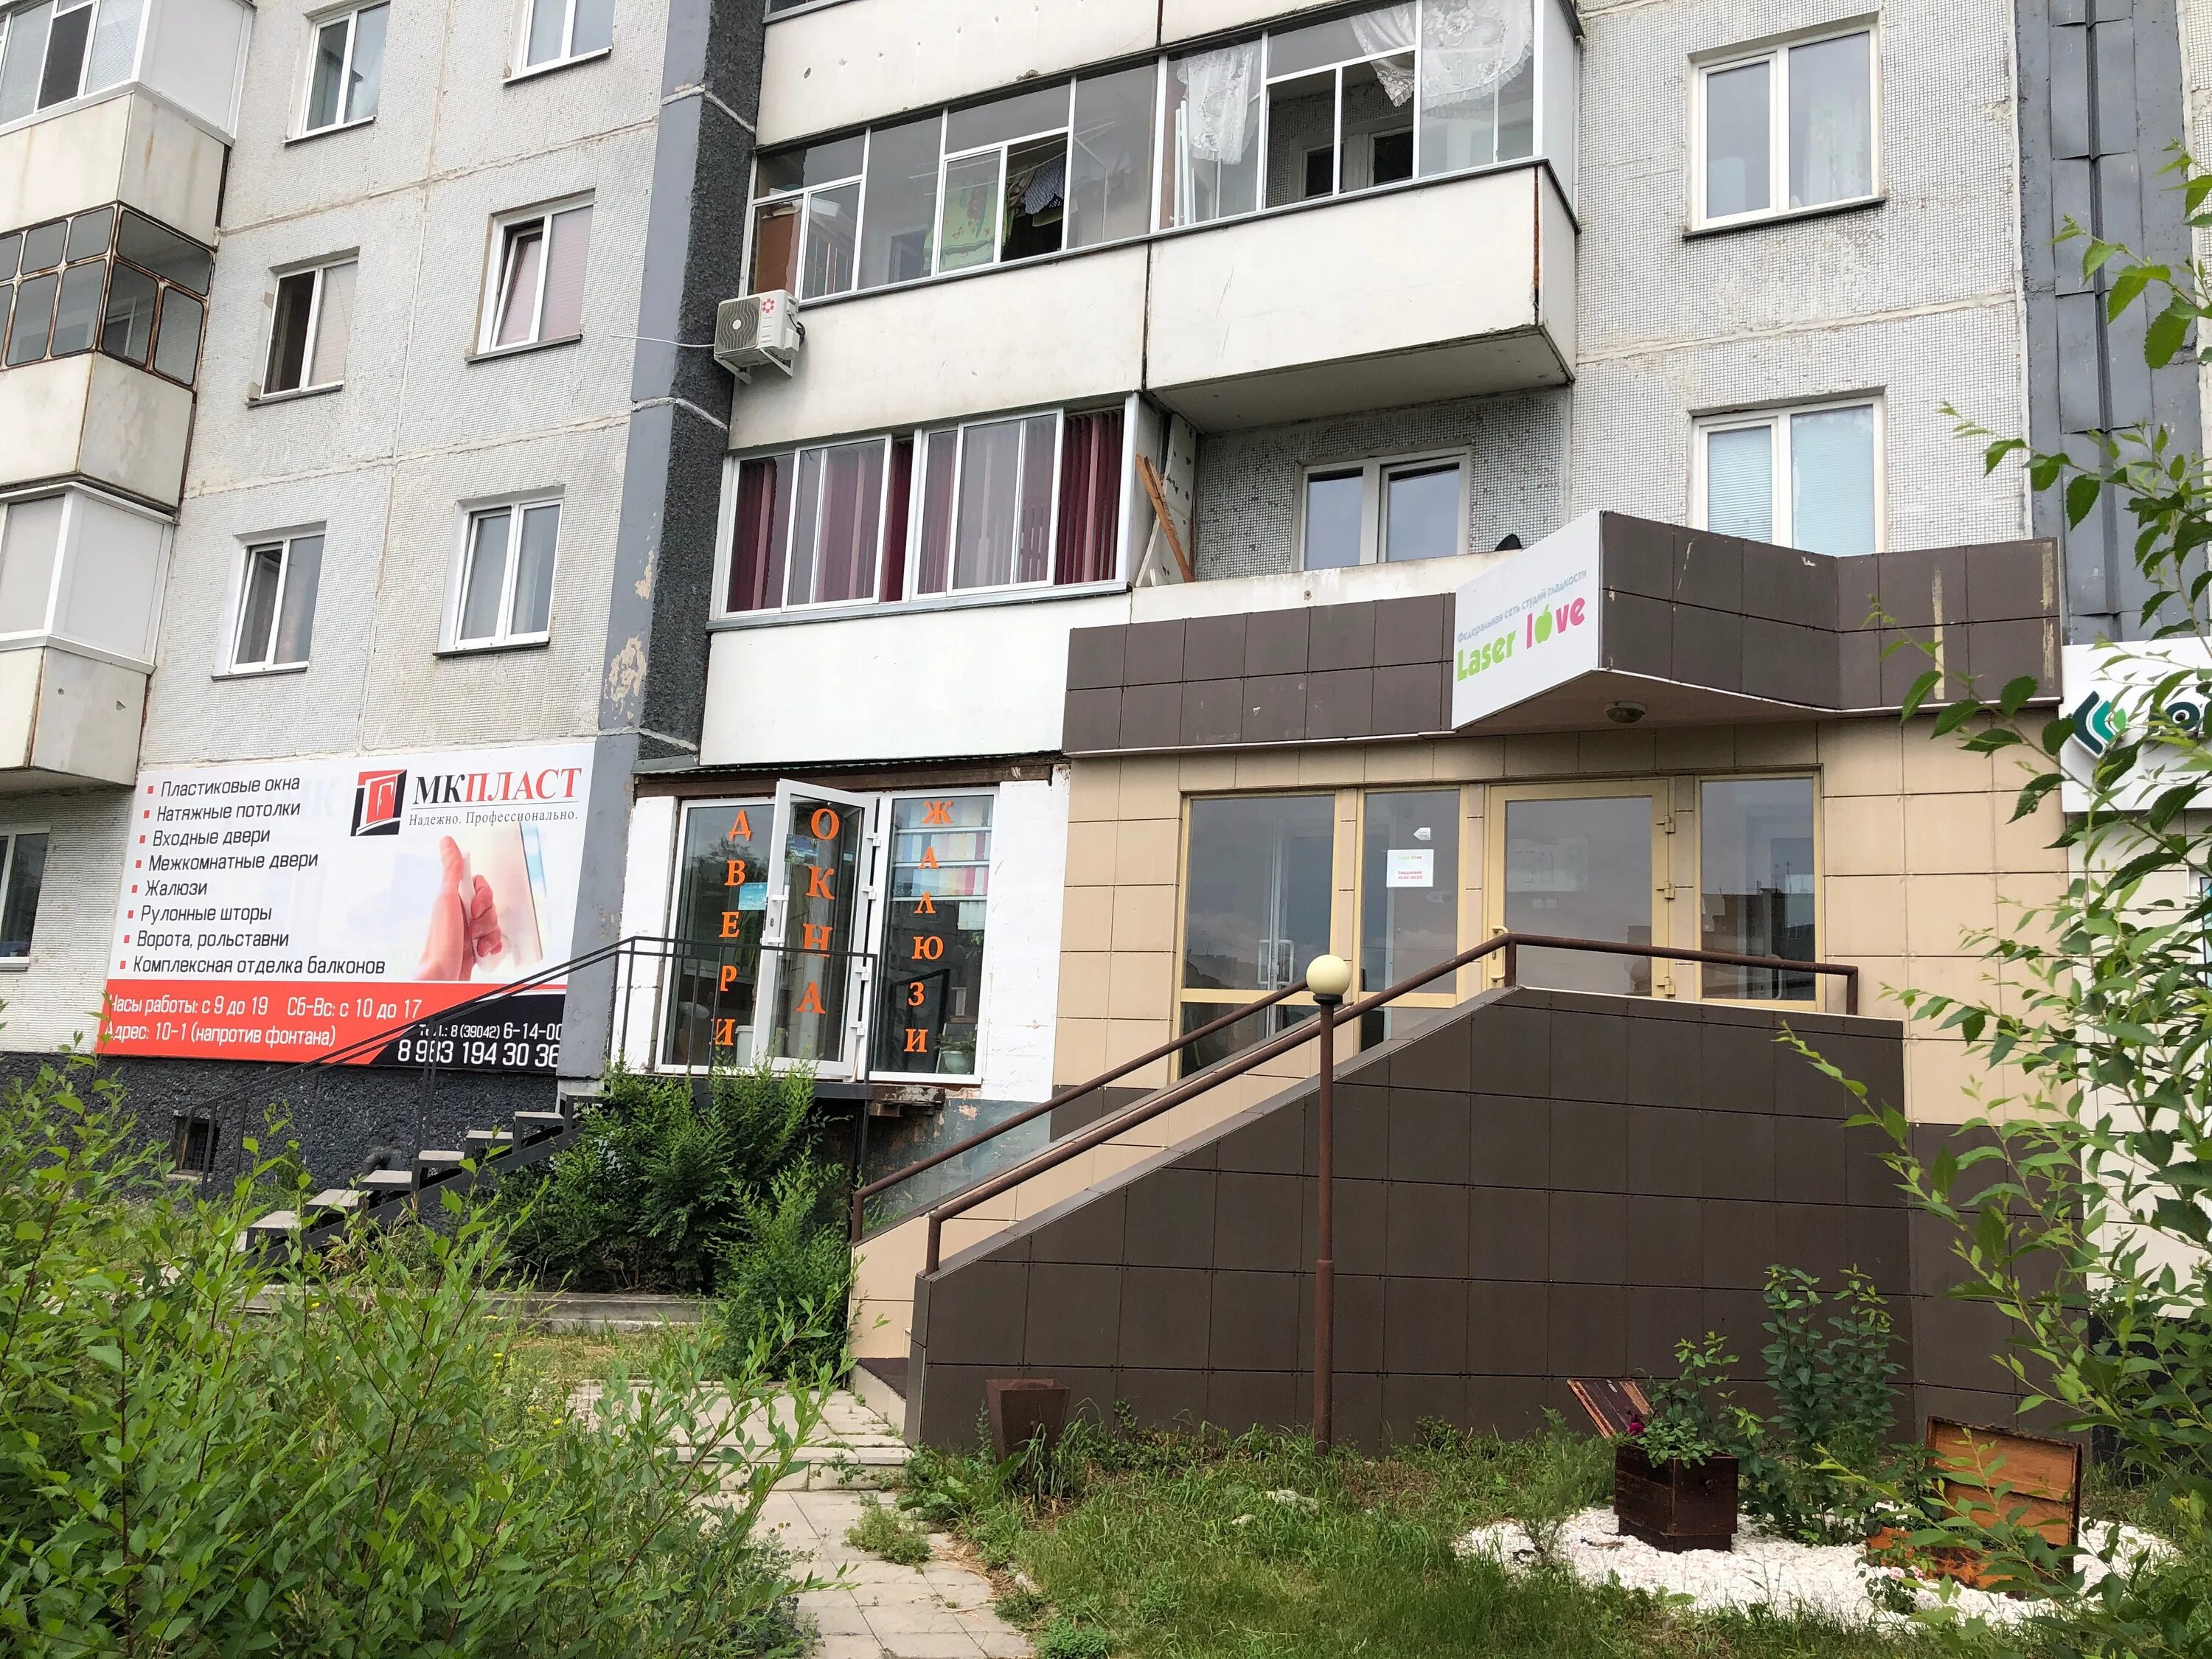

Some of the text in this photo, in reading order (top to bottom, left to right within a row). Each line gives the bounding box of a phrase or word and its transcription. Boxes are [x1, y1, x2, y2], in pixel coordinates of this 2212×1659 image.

[1457, 597, 1585, 682] Laser love
[160, 776, 300, 798] Пластиковые окна
[412, 768, 582, 804] МКПЛАСТ
[156, 802, 301, 822] Натяжные потолки
[408, 810, 578, 827] Надежно. Профессионально.
[152, 830, 271, 847] Входные двери
[148, 854, 319, 872] Межкомнатные двери
[145, 879, 208, 897] Жалюзи
[140, 905, 272, 925] Рулонные шторы
[796, 808, 841, 1015] ОКНА
[710, 809, 753, 1046] ДВЕРИ
[904, 801, 954, 1053] ЖАЛЮЗИ
[136, 930, 289, 951] Ворота, рольставни
[133, 955, 386, 975] Комплексная отделка балконов
[144, 994, 198, 1017] работы:
[201, 999, 211, 1014] с
[213, 995, 225, 1015] 9
[226, 1000, 246, 1016] до
[251, 995, 269, 1015] 19
[287, 996, 423, 1020] Сб-Вс: с 10 до 17
[104, 1020, 336, 1048] Адрес: 10-1 (напротив фонтана)
[451, 1024, 459, 1037] 8
[460, 1023, 500, 1040] (39042)
[503, 1022, 563, 1041] 6-14-00
[397, 1039, 560, 1068] 8 983 194 30 36
